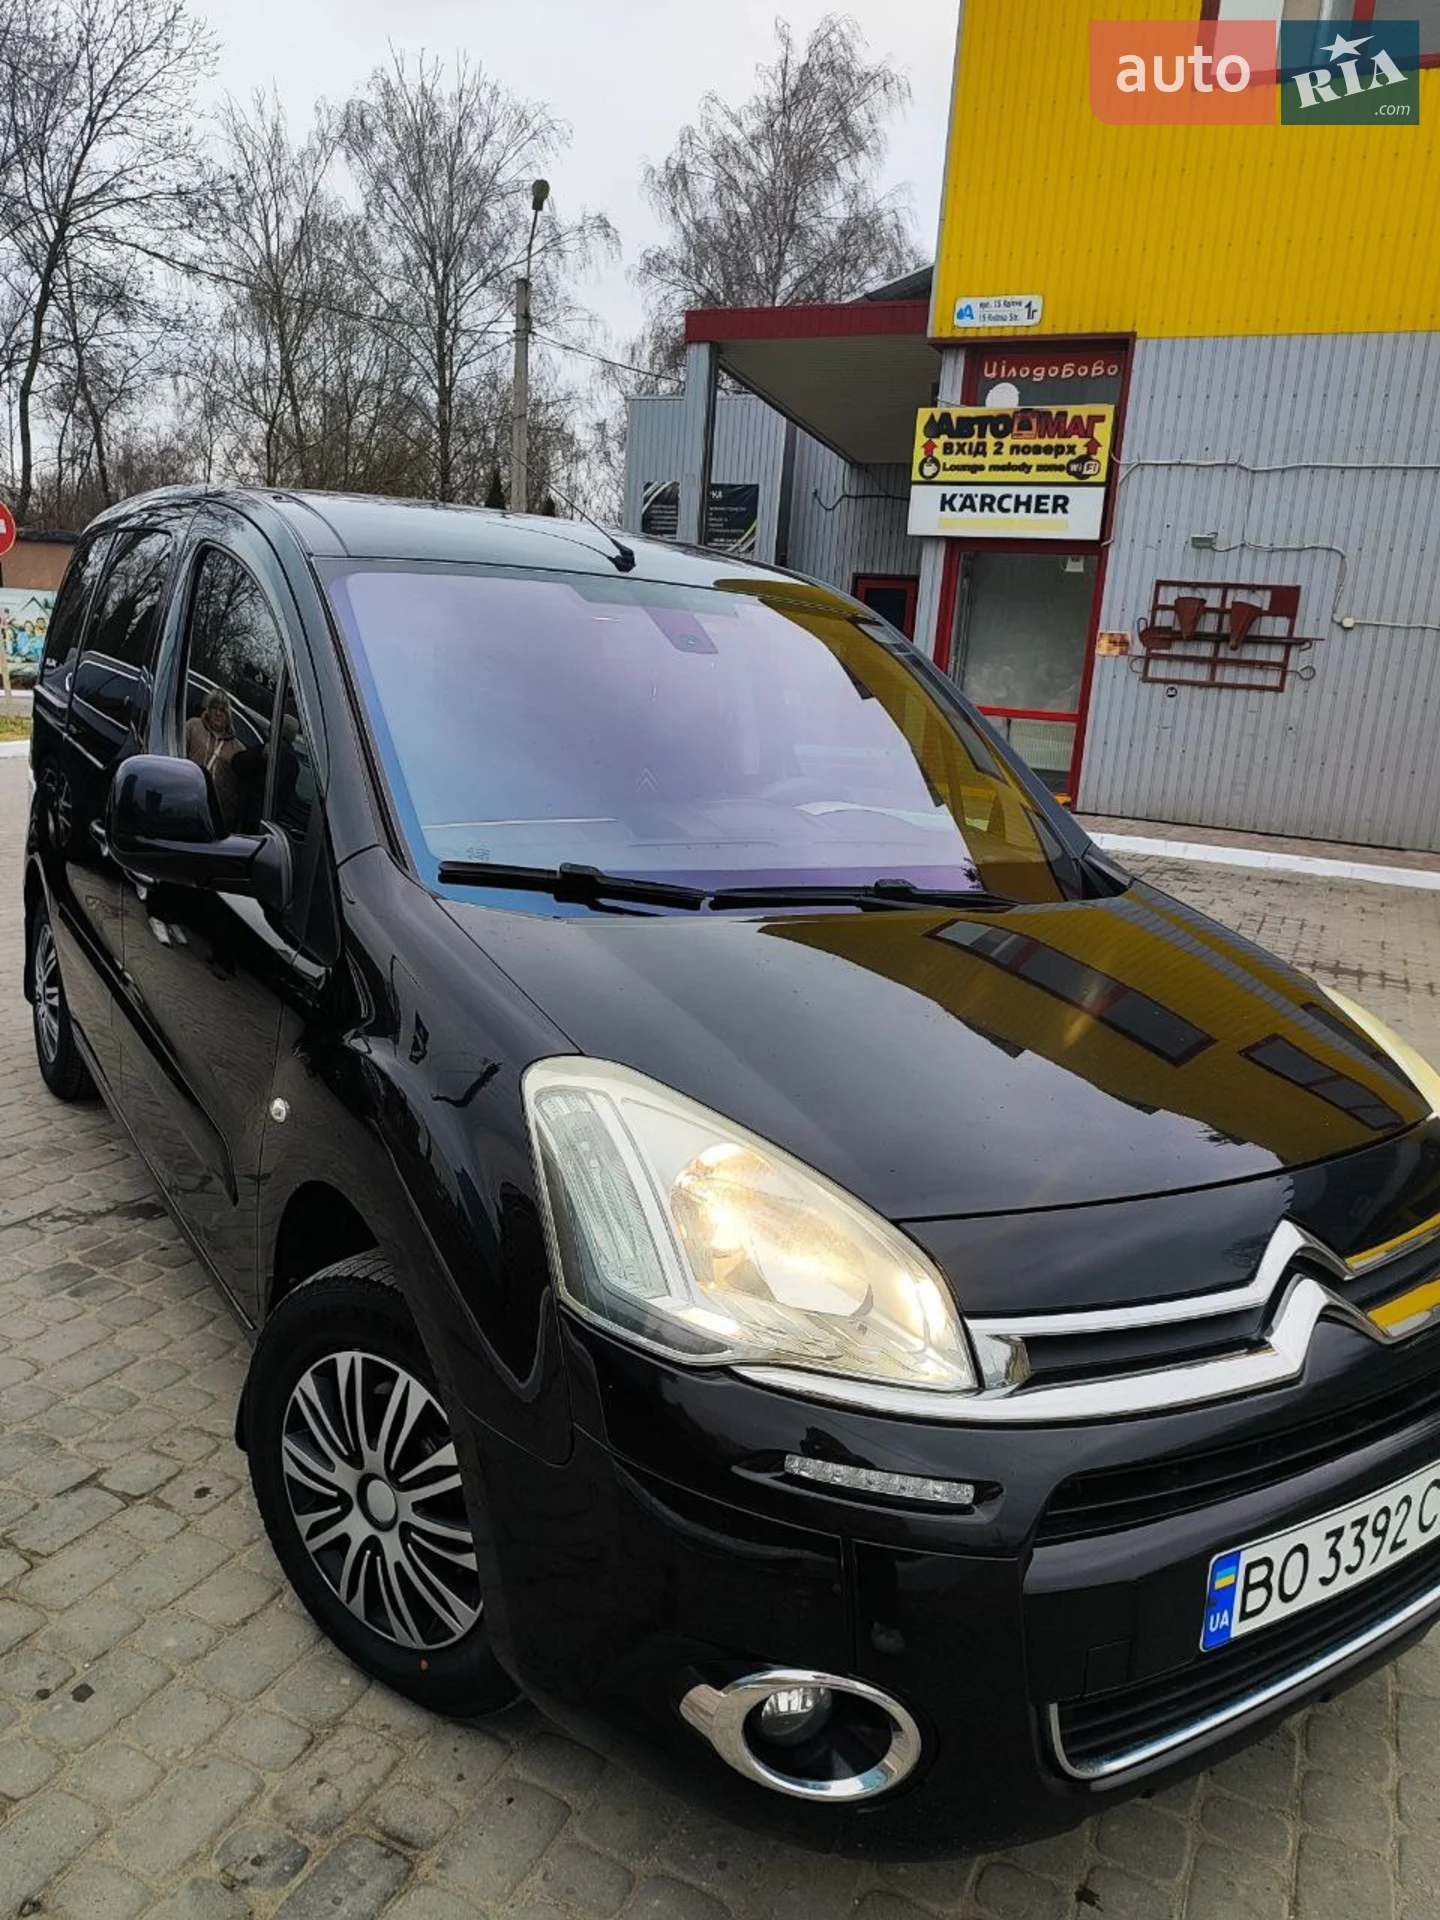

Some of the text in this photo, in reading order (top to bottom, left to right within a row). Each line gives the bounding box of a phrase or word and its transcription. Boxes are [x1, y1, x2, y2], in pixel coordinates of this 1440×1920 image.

[943, 441, 1077, 458] ВХІД 2 поверх
[942, 462, 986, 474] Lounge
[940, 493, 1070, 514] KÄRCHER
[1239, 1543, 1309, 1623] BO
[1318, 1494, 1412, 1587] 3392
[1209, 1609, 1230, 1633] UA
